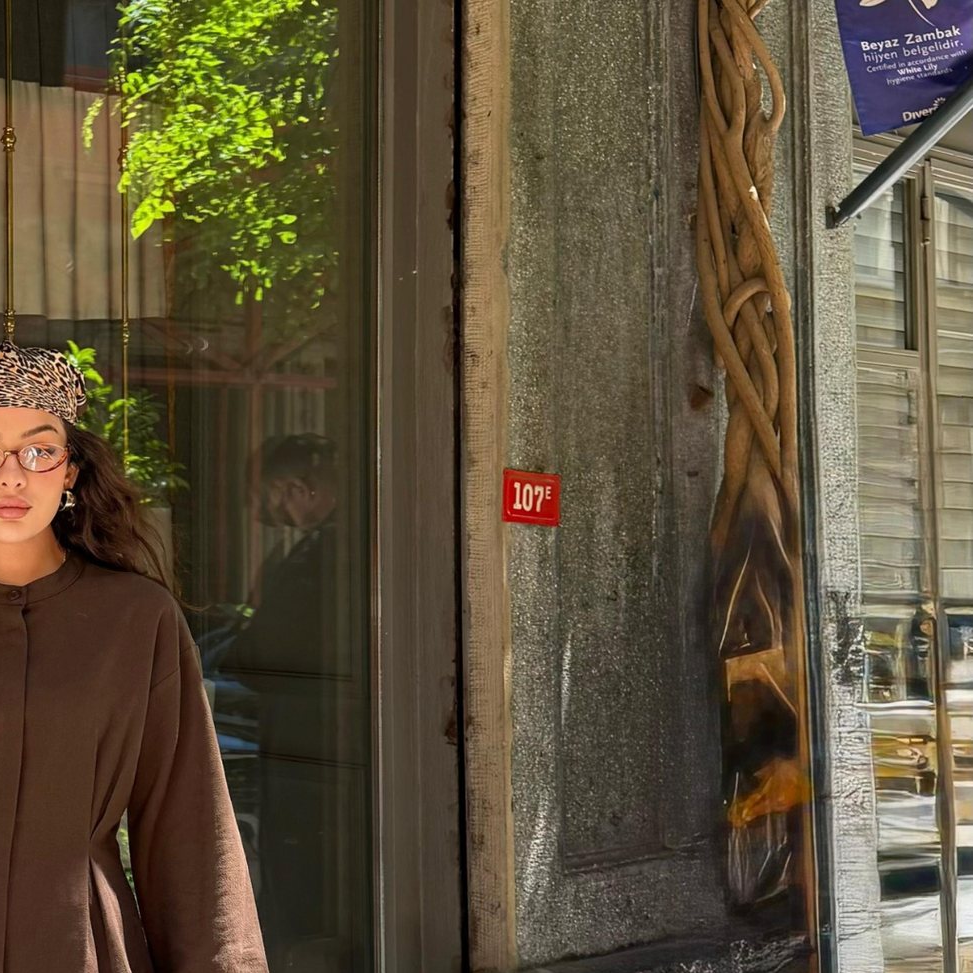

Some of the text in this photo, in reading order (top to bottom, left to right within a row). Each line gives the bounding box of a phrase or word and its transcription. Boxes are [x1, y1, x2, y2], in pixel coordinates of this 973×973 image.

[861, 26, 961, 51] Beyaz Zambak
[863, 40, 964, 63] hijyen belgelidir.
[867, 63, 896, 73] Certified
[907, 54, 948, 66] accordance
[950, 50, 967, 58] with
[887, 68, 953, 85] hygiene standards
[896, 63, 938, 76] White Lily
[902, 107, 935, 122] Diver
